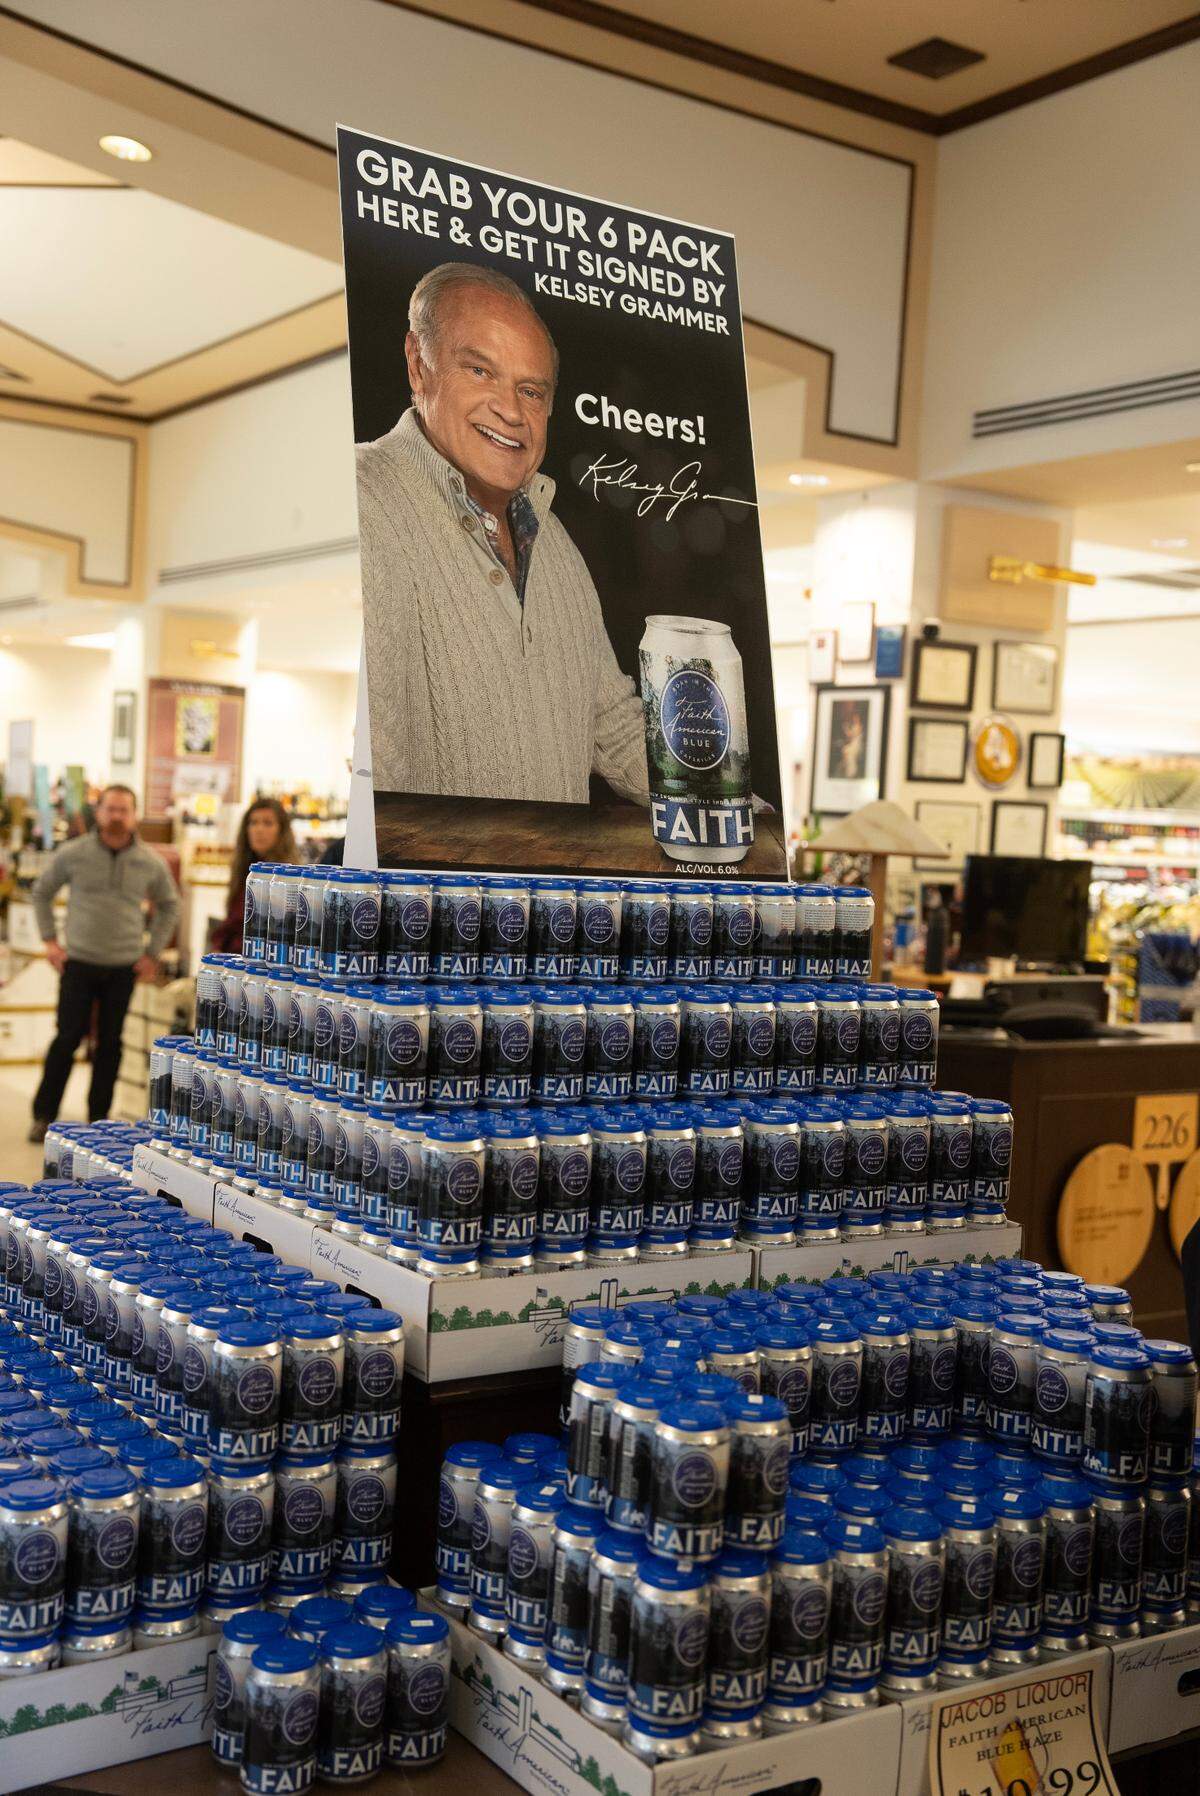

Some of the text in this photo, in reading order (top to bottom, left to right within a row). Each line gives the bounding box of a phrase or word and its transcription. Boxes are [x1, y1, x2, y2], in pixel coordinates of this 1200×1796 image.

[356, 149, 725, 276] GRAB YOUR 6 PACK
[357, 190, 726, 307] HERE & GET IT SIGNED BY
[534, 272, 730, 335] KELSEY GRAMMER
[574, 393, 706, 445] Cheers!
[665, 711, 726, 738] American
[676, 696, 724, 720] Faith
[683, 737, 710, 748] BLUE
[651, 801, 754, 844] FAITH
[675, 864, 739, 875] ALC/VOL 6.0%
[899, 1065, 937, 1081] AITH
[1144, 1113, 1189, 1148] 226
[1031, 1428, 1082, 1454] AITH
[653, 1522, 723, 1553] FAITH
[941, 1694, 1007, 1729] JACOB
[1016, 1674, 1088, 1709] LIQUOR
[948, 1704, 1087, 1749] FAITH AMERICAN
[977, 1729, 1064, 1763] BLUE HAZE
